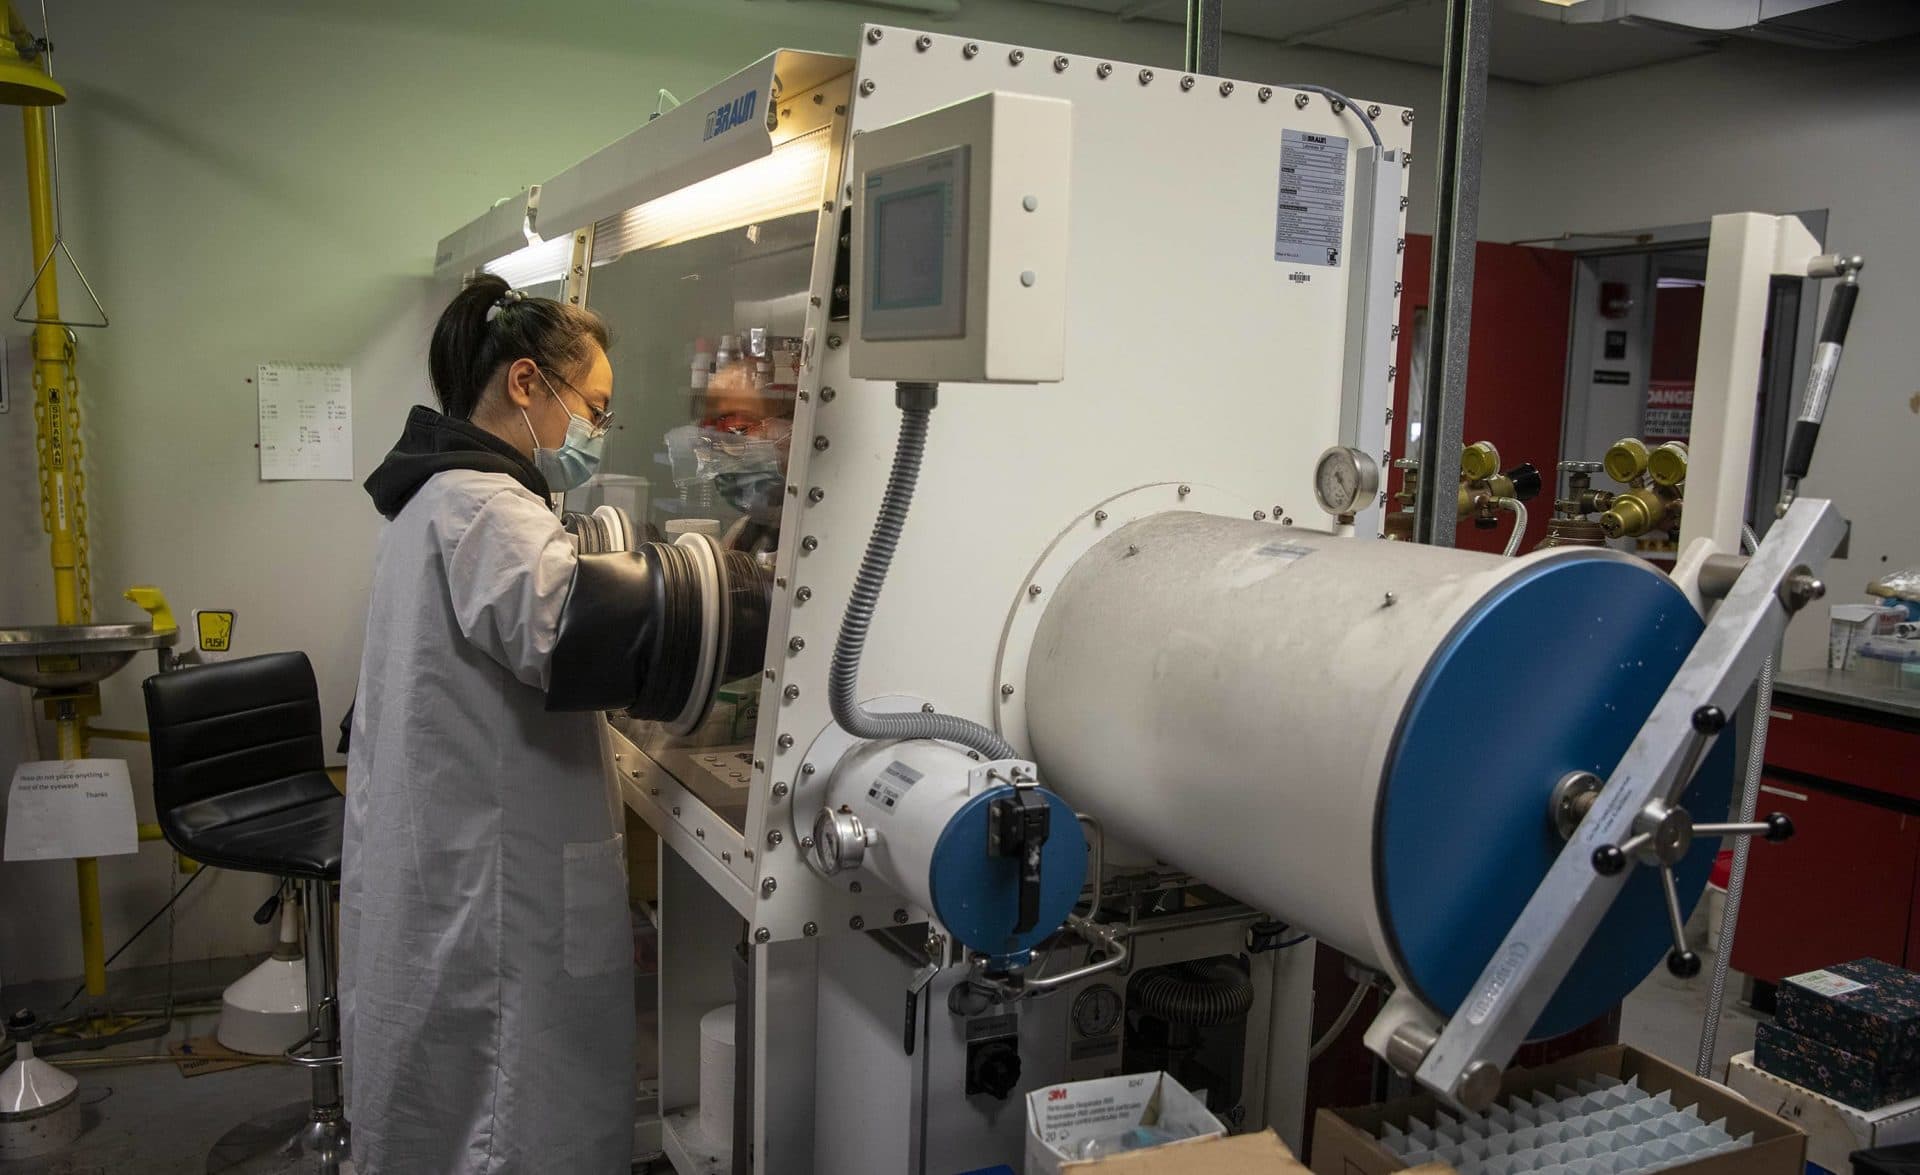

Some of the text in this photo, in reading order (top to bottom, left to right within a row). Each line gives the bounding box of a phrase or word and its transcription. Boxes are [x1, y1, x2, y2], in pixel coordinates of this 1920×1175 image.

[51, 405, 62, 465] SPEAKMAN
[206, 637, 225, 648] PUSH
[56, 772, 74, 782] place
[75, 771, 103, 781] anything
[50, 781, 79, 792] eyewash
[1048, 1088, 1067, 1101] 3M
